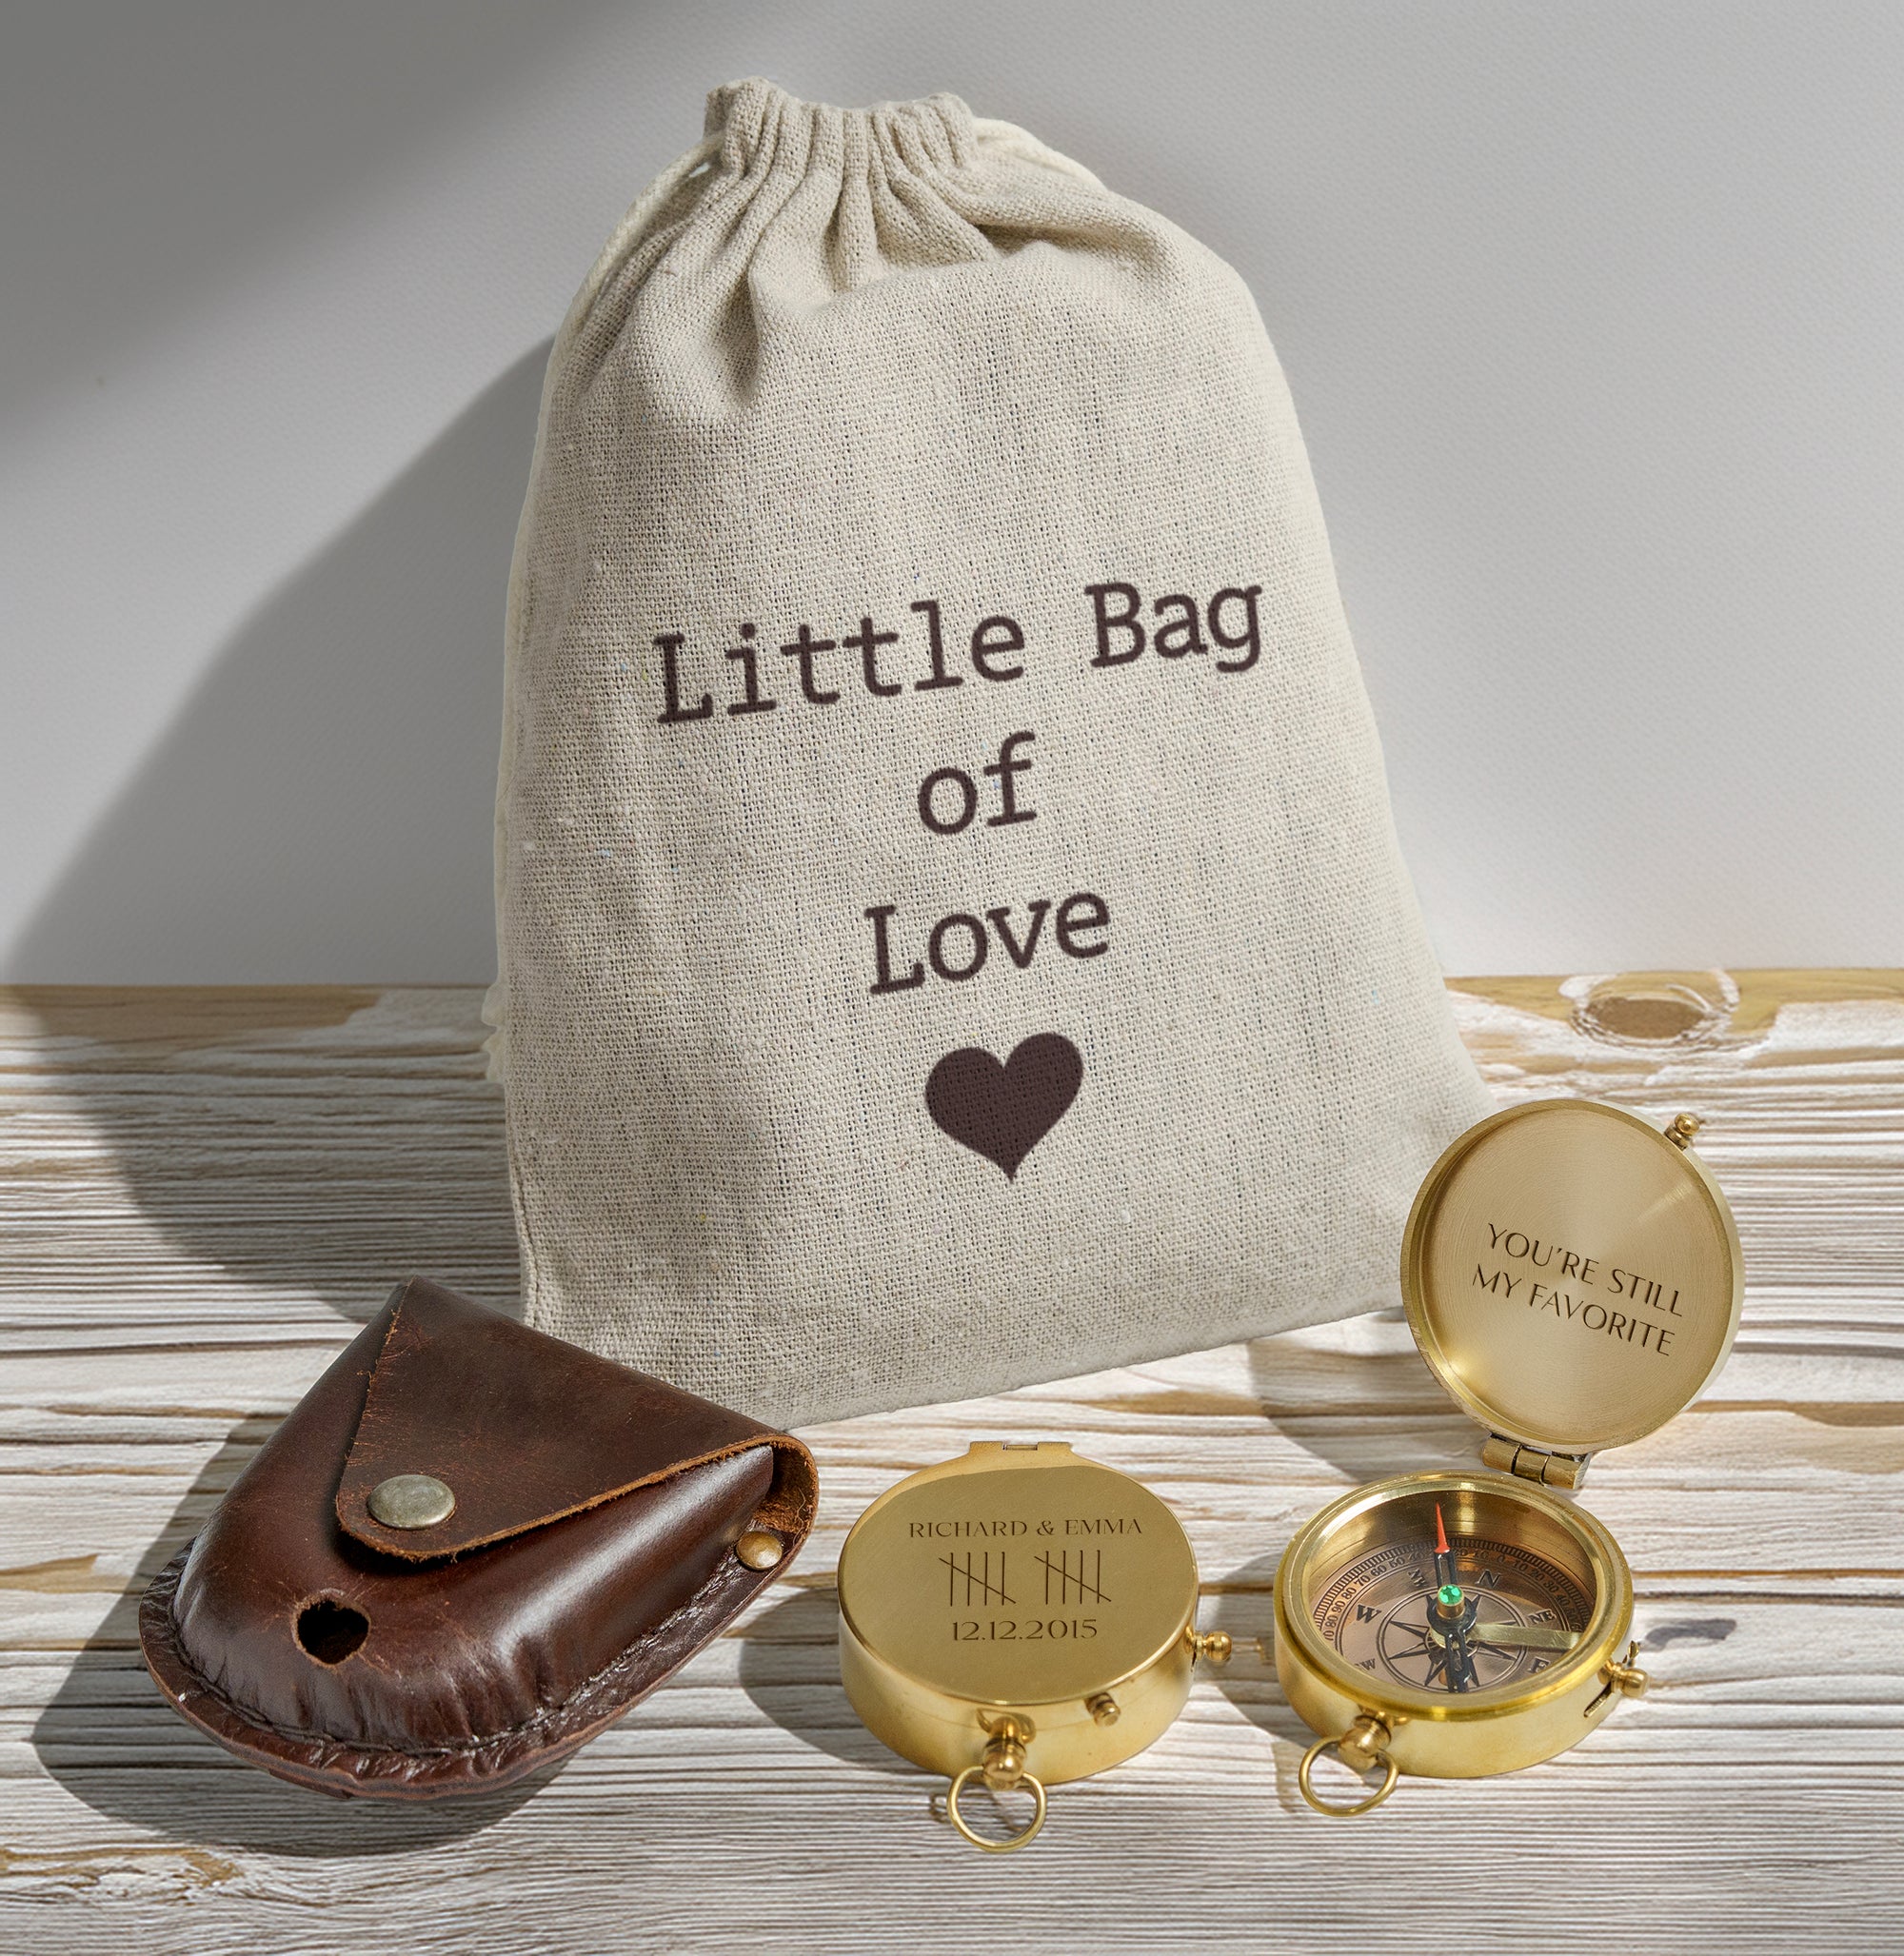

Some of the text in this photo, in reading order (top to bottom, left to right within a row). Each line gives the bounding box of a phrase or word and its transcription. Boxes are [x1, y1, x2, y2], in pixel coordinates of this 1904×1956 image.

[653, 581, 1263, 725] Little Bag
[917, 730, 1038, 836] of
[863, 891, 1111, 996] Love
[1487, 1222, 1683, 1317] YOU'RE STILL
[1473, 1263, 1676, 1357] MY FAVORITE
[909, 1518, 1142, 1538] RICHARD & EMMA
[1331, 1599, 1346, 1613] 90
[1341, 1586, 1358, 1600] 80
[1354, 1574, 1371, 1587] 70
[1475, 1569, 1502, 1589] N
[952, 1618, 1098, 1641] 12.12.2015
[1357, 1604, 1382, 1624] W
[1527, 1609, 1557, 1625] NE
